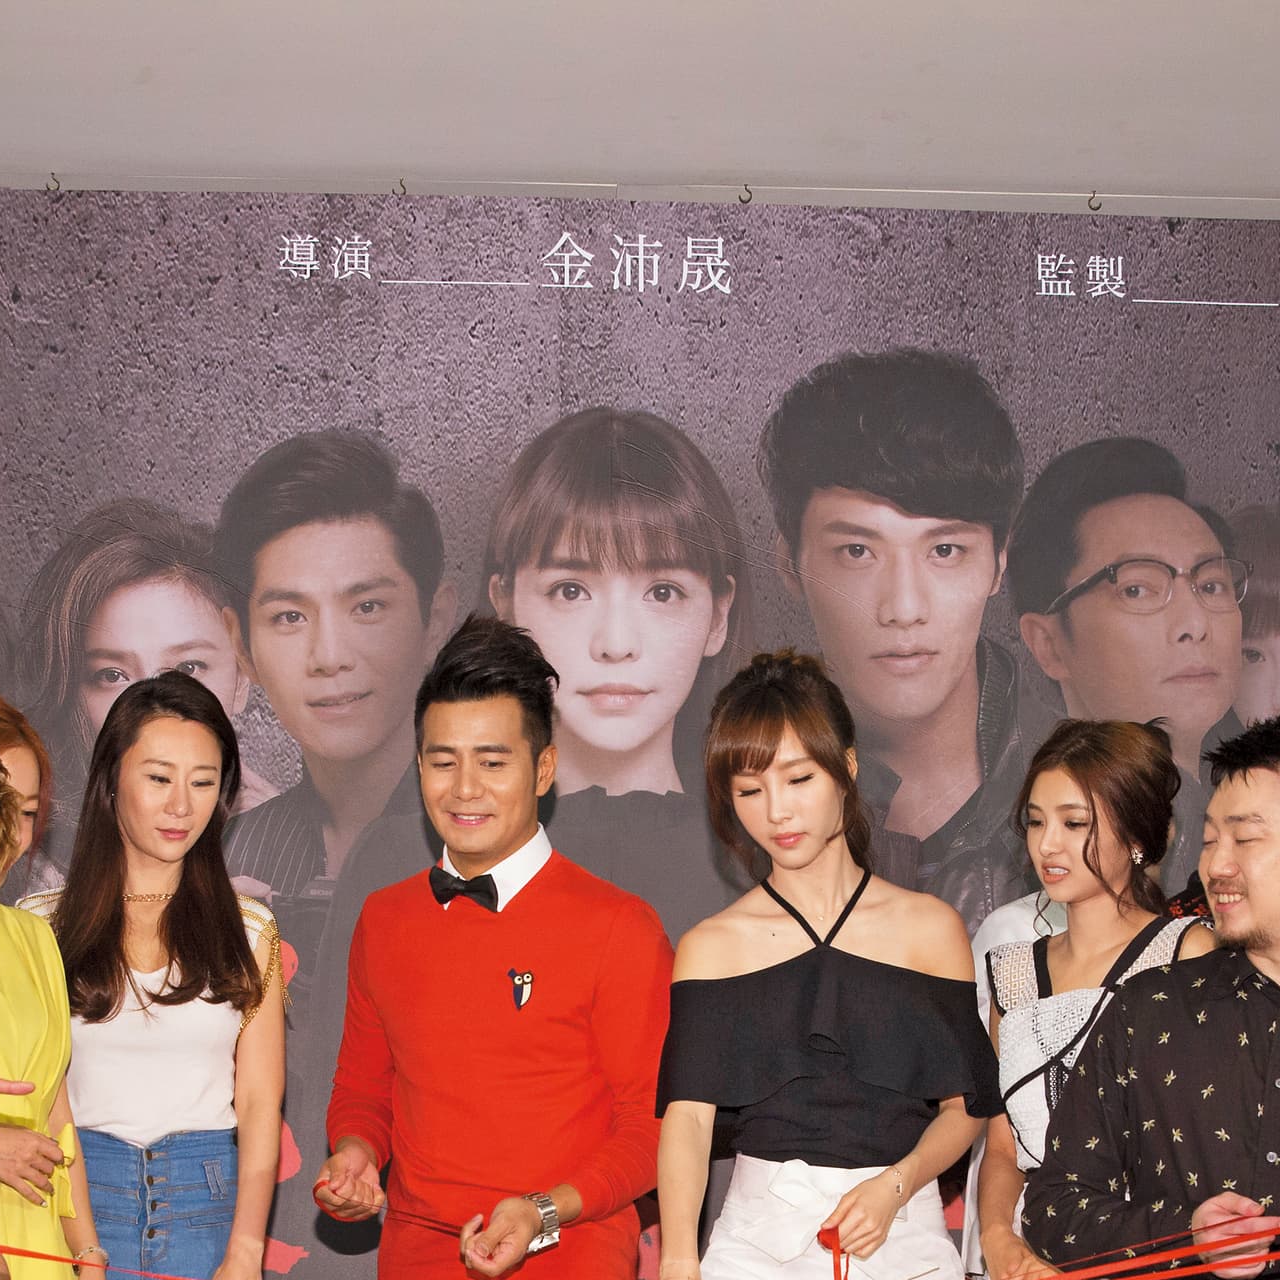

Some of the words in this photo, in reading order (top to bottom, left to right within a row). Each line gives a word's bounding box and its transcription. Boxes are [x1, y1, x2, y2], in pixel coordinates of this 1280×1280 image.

[278, 233, 373, 281] 導演
[539, 231, 733, 295] 金沛晟
[1035, 253, 1127, 299] 監製
